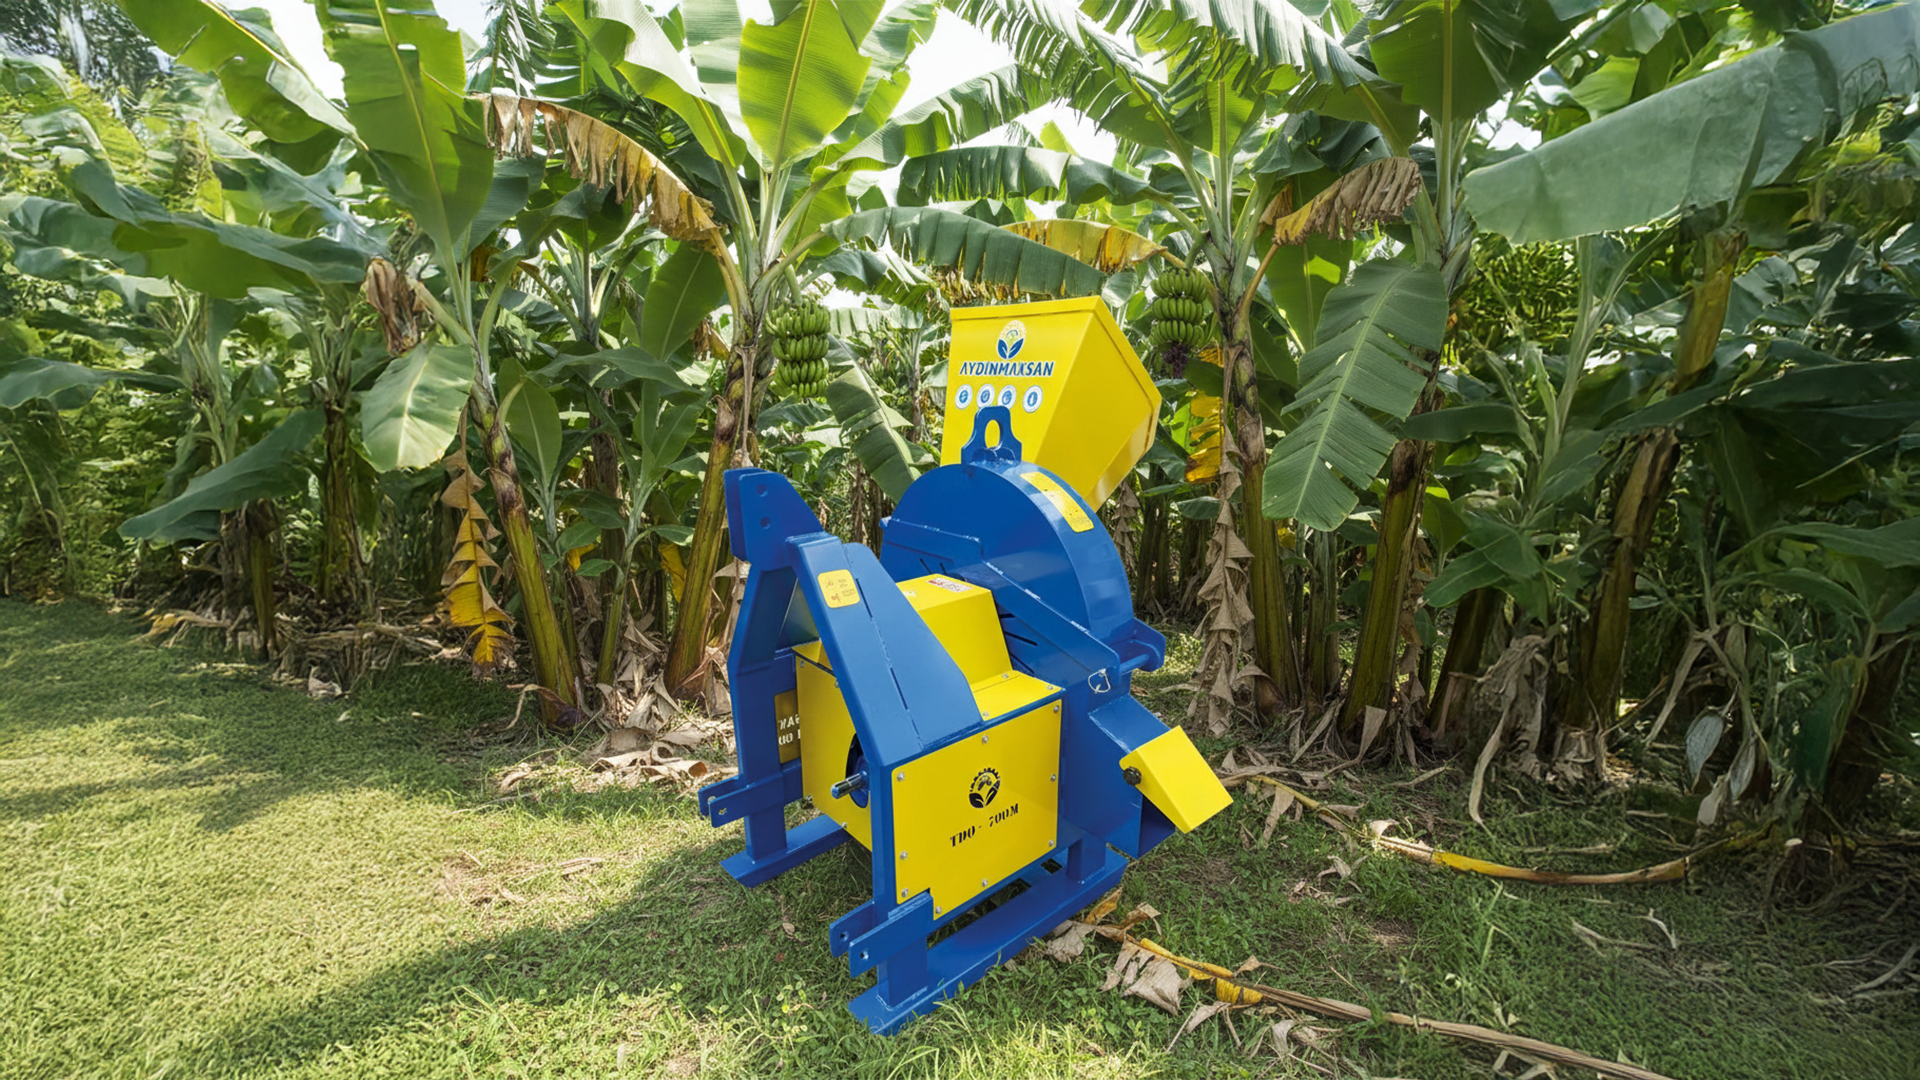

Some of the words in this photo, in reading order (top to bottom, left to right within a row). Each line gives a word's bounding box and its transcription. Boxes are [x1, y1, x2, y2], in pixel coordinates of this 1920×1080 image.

[959, 361, 1054, 377] AYDINMAKSAN
[950, 825, 975, 847] TDO
[989, 803, 1018, 827] 700M
